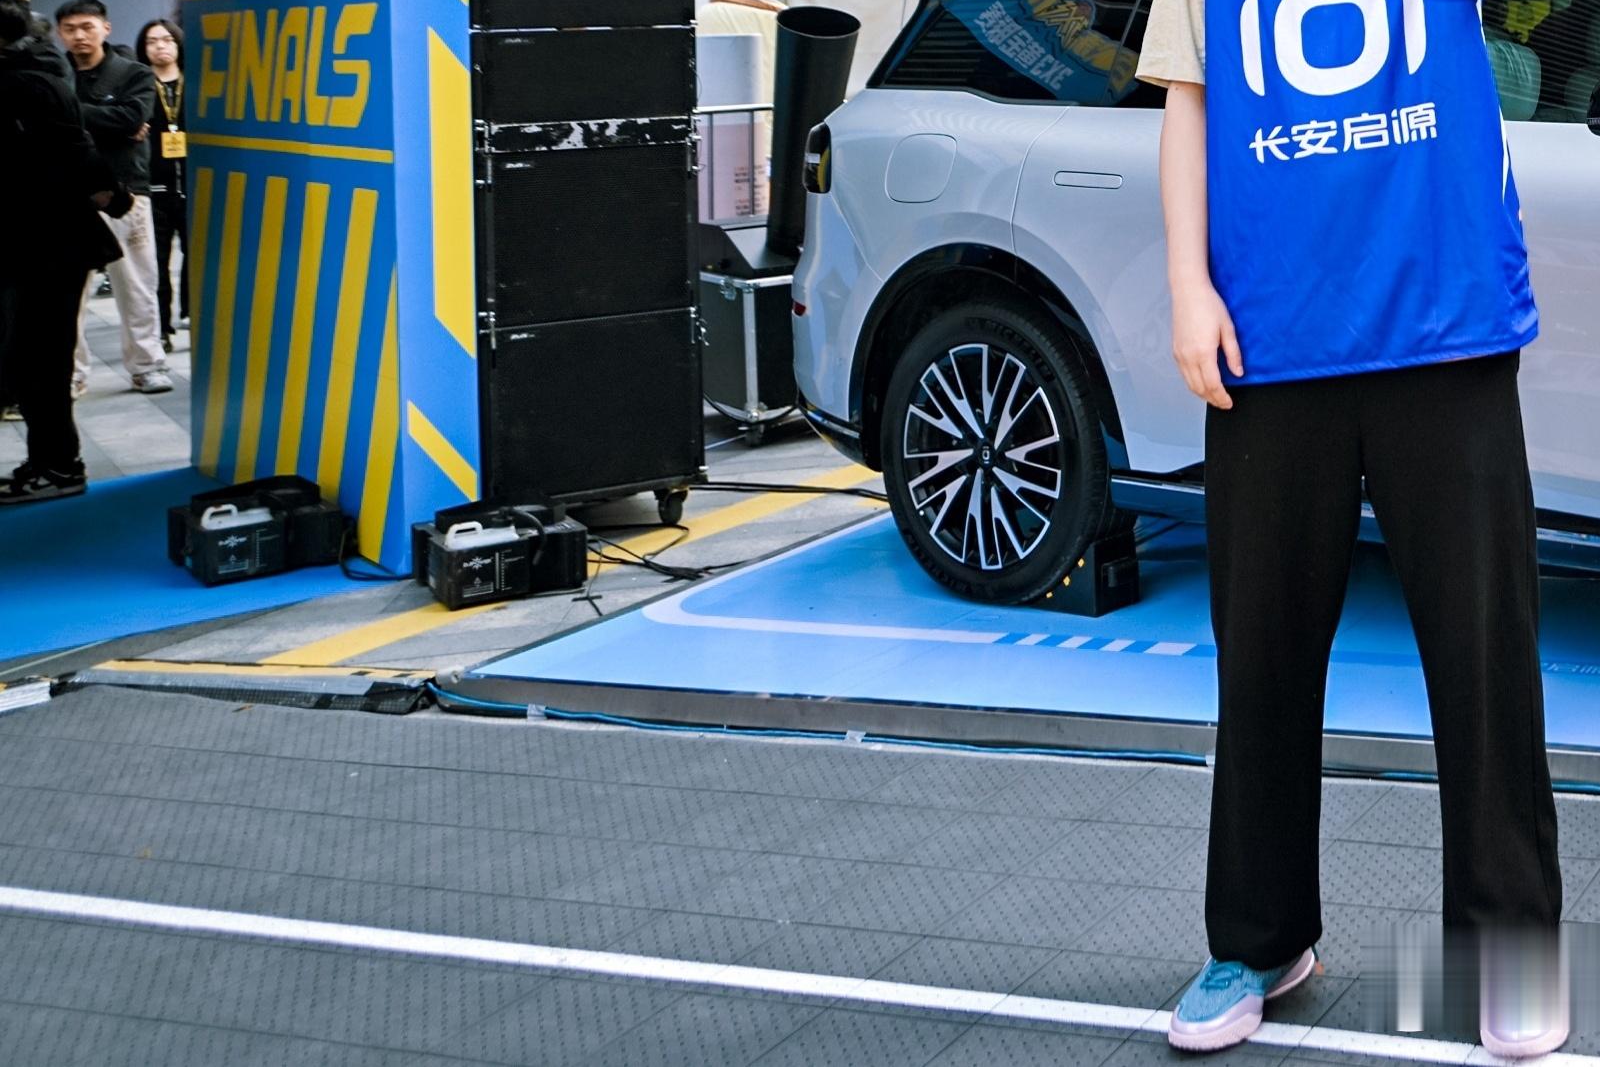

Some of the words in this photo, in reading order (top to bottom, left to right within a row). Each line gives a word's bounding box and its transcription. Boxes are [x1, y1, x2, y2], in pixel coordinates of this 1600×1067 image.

[198, 3, 378, 128] FINALS
[1248, 102, 1438, 164] 长安启源
